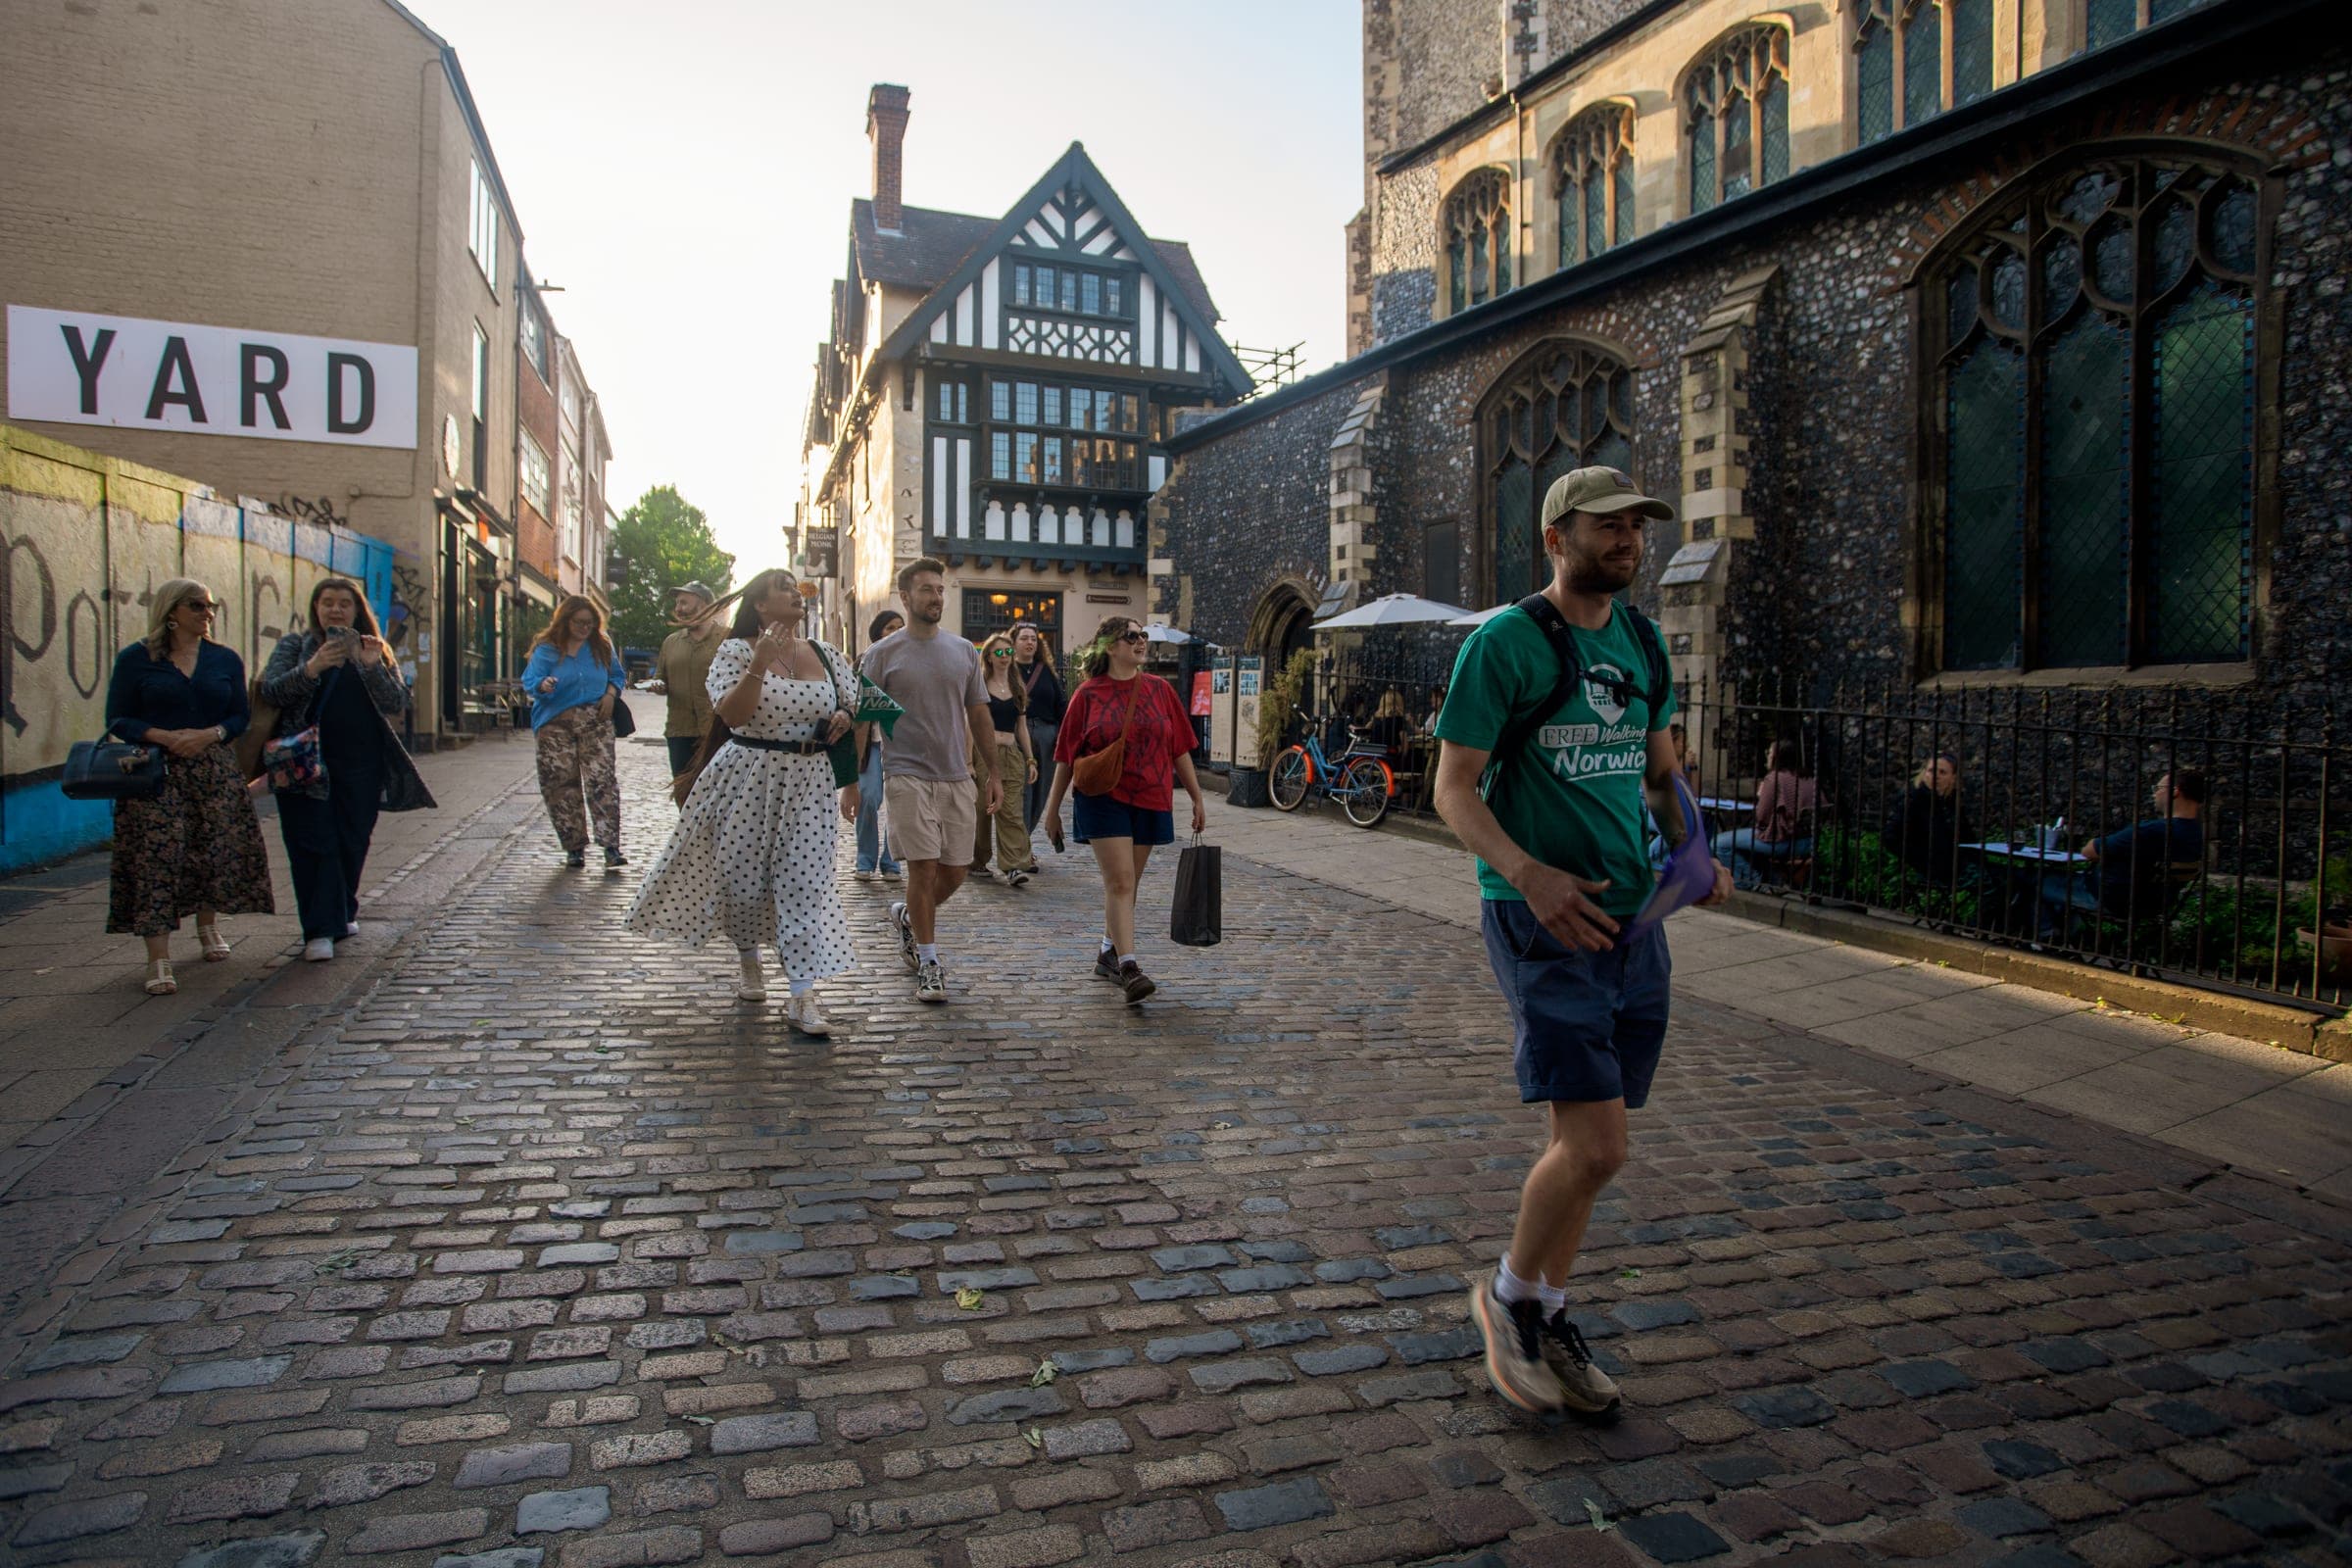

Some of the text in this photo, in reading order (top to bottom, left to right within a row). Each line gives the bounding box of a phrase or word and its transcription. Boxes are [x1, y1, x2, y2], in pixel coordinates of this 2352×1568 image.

[60, 324, 375, 434] YARD
[1544, 724, 1647, 745] FREE Walking
[1554, 745, 1646, 774] Norwic
